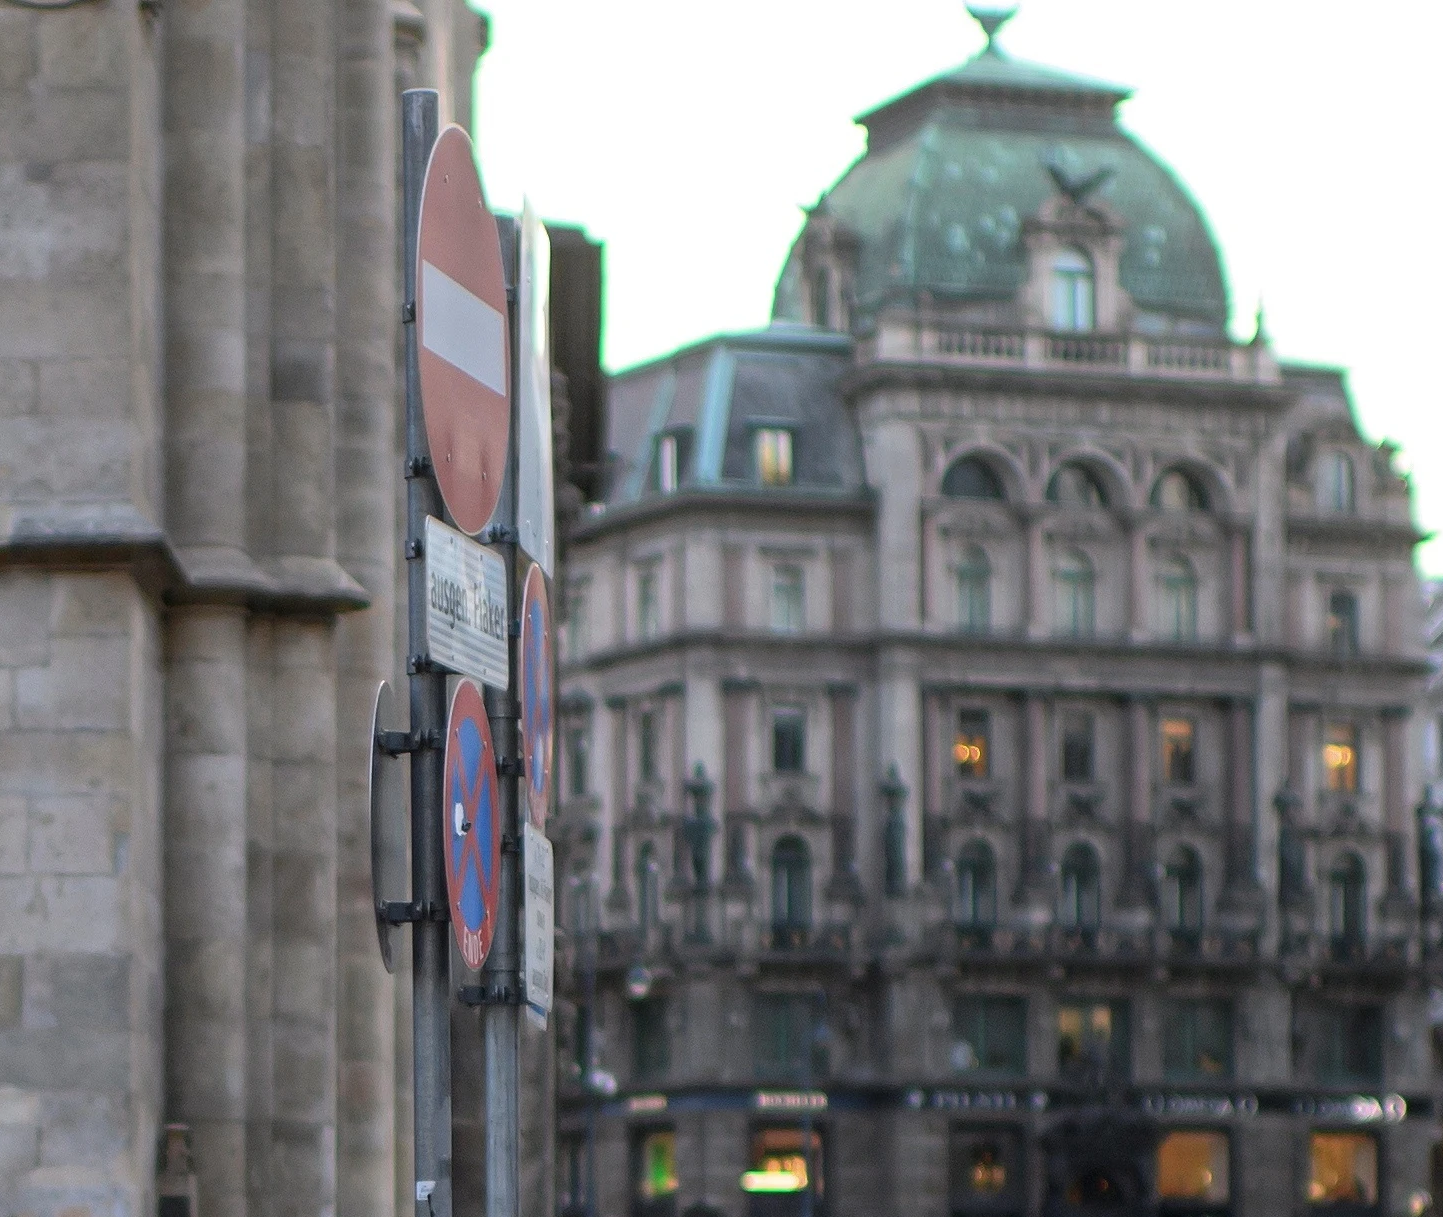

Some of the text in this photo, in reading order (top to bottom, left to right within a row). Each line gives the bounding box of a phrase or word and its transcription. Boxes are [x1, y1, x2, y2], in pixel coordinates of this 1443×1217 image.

[431, 571, 505, 641] ausgen. Fiaker
[463, 925, 484, 965] ENDE
